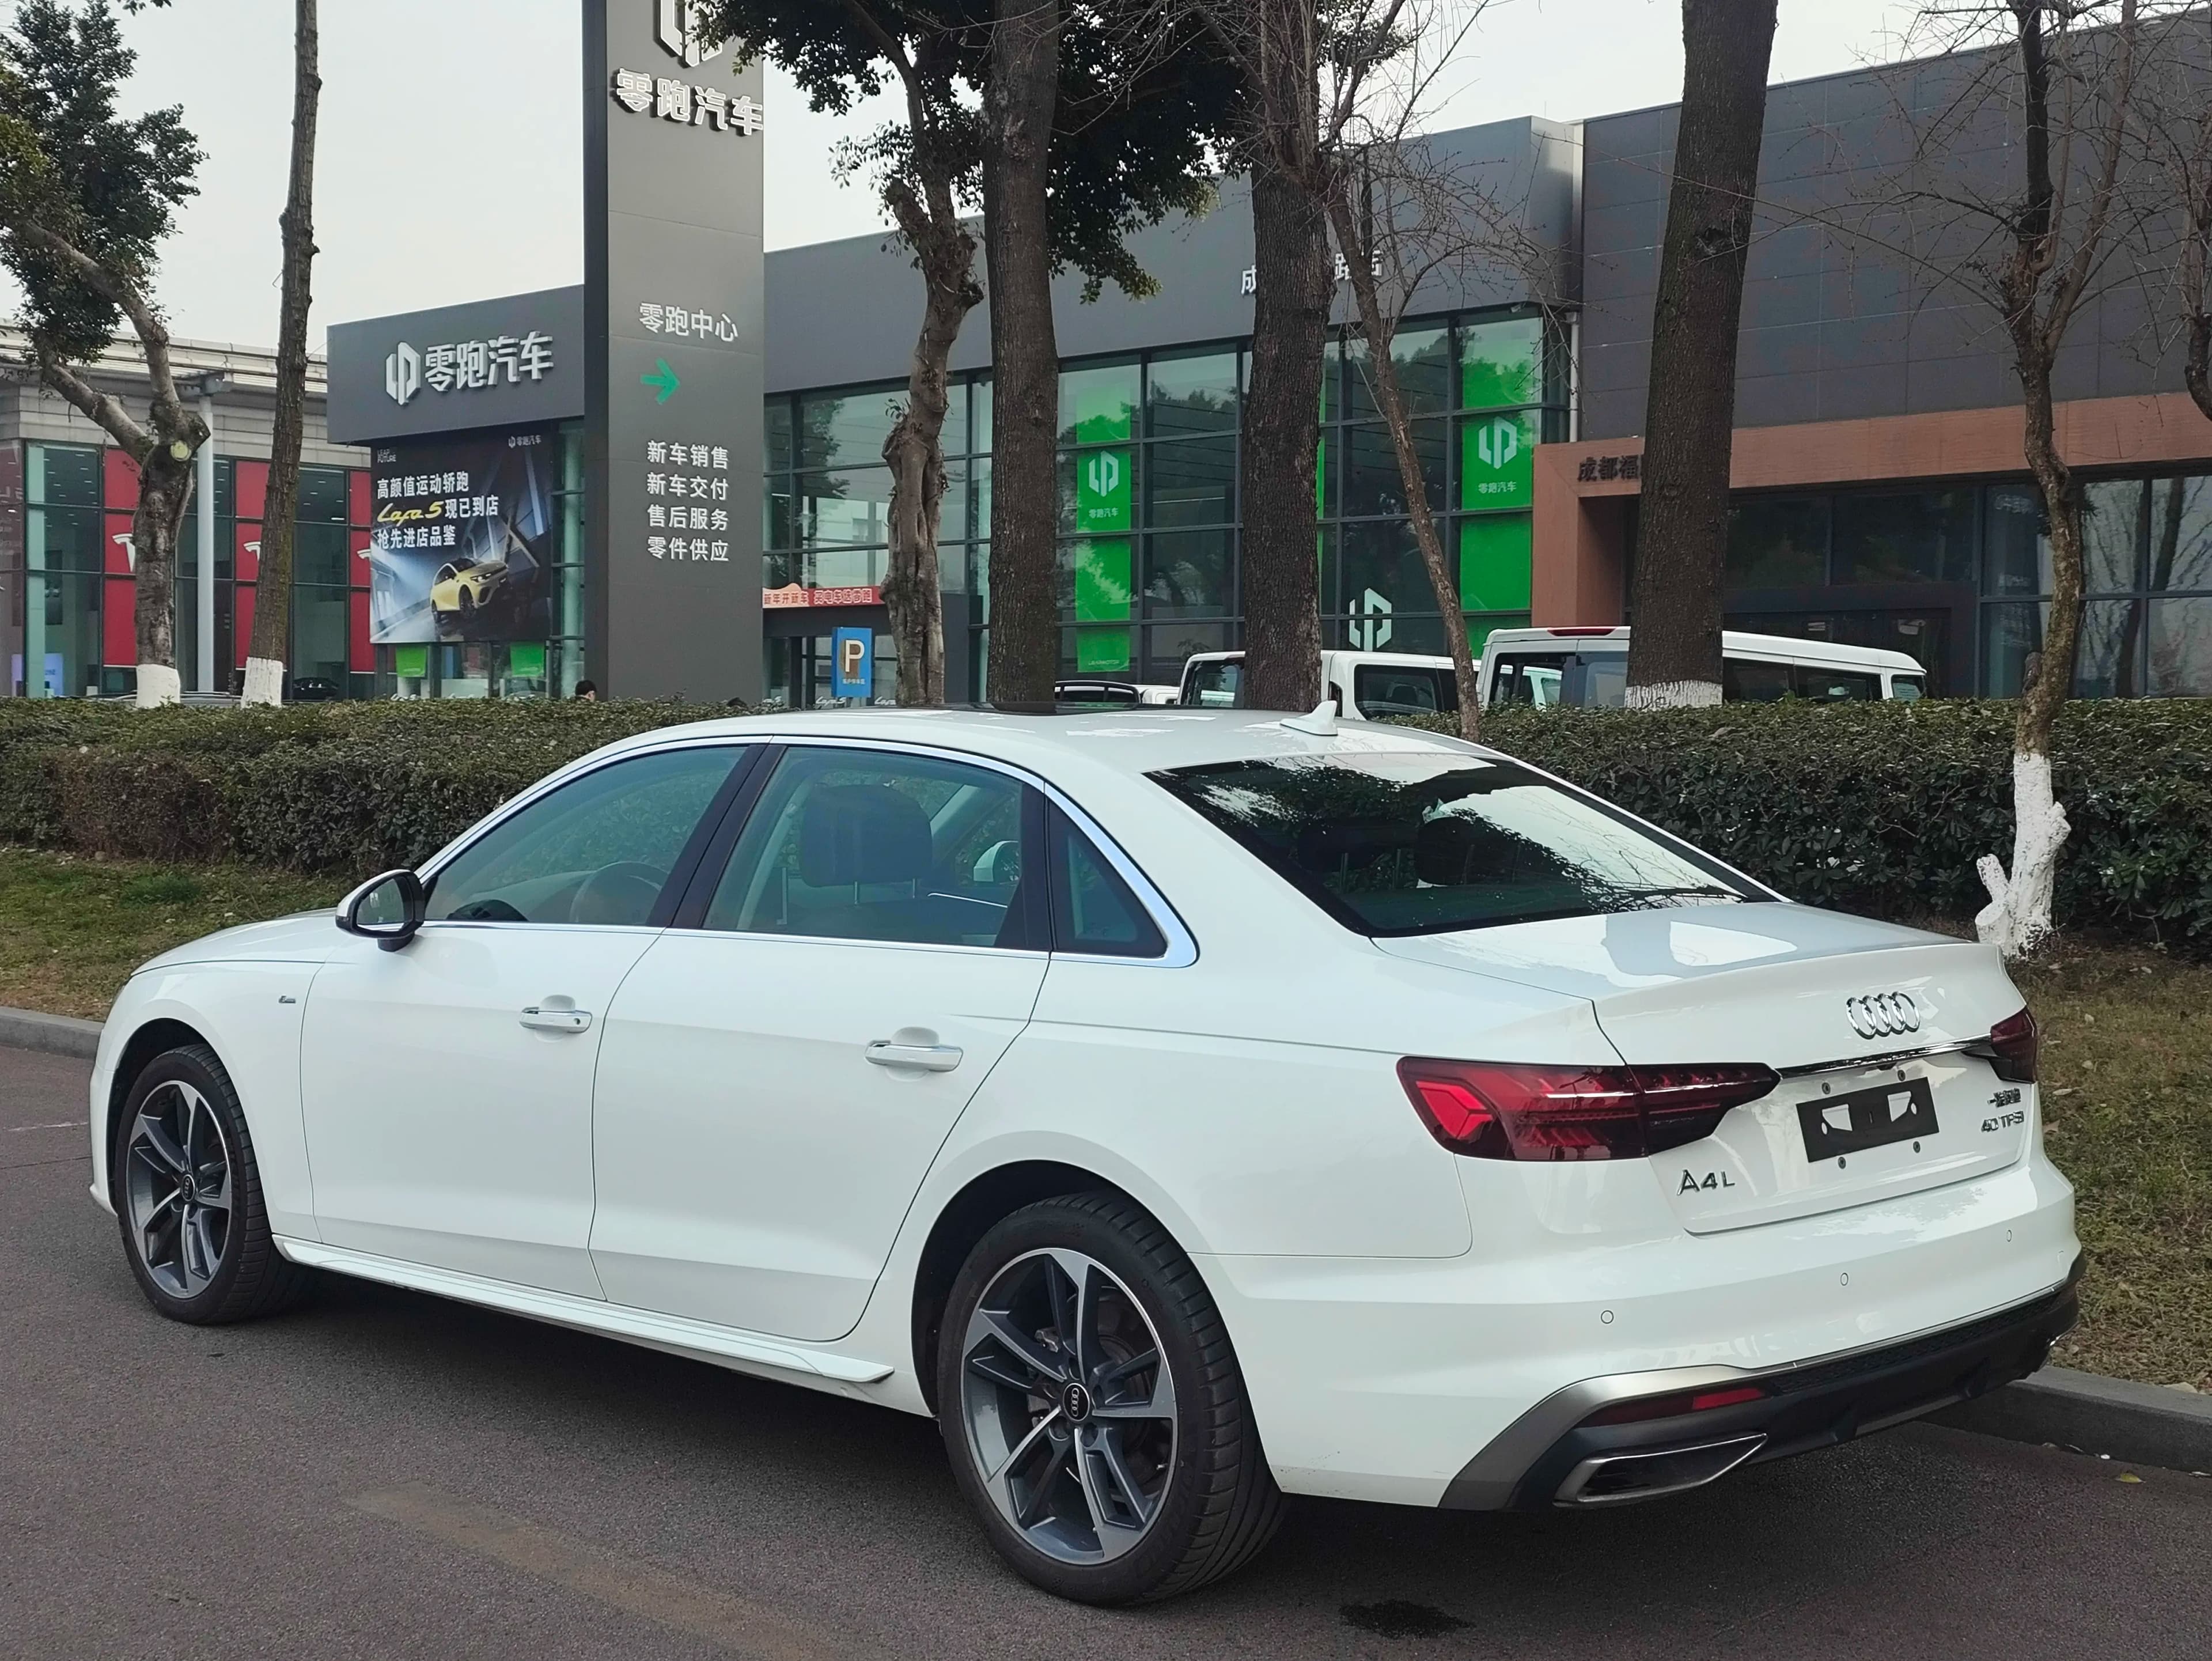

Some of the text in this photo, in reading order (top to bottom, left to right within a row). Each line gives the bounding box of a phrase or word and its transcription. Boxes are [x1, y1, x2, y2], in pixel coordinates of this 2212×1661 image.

[616, 67, 763, 135] 零跑汽车
[639, 301, 738, 342] 零跑中心
[425, 330, 554, 392] 零跑汽车
[646, 440, 729, 470] 新车销售
[1577, 454, 1644, 482] 成都福
[377, 470, 469, 500] 高颜值运动轿跑
[646, 471, 729, 501] 新车交付
[647, 504, 729, 531] 售后服务
[377, 524, 456, 550] 抢先进店品鉴
[647, 535, 729, 562] 零件供应
[844, 639, 865, 672] P
[1980, 1110, 2025, 1133] 40 TFSI
[1676, 1169, 1736, 1196] A4L
